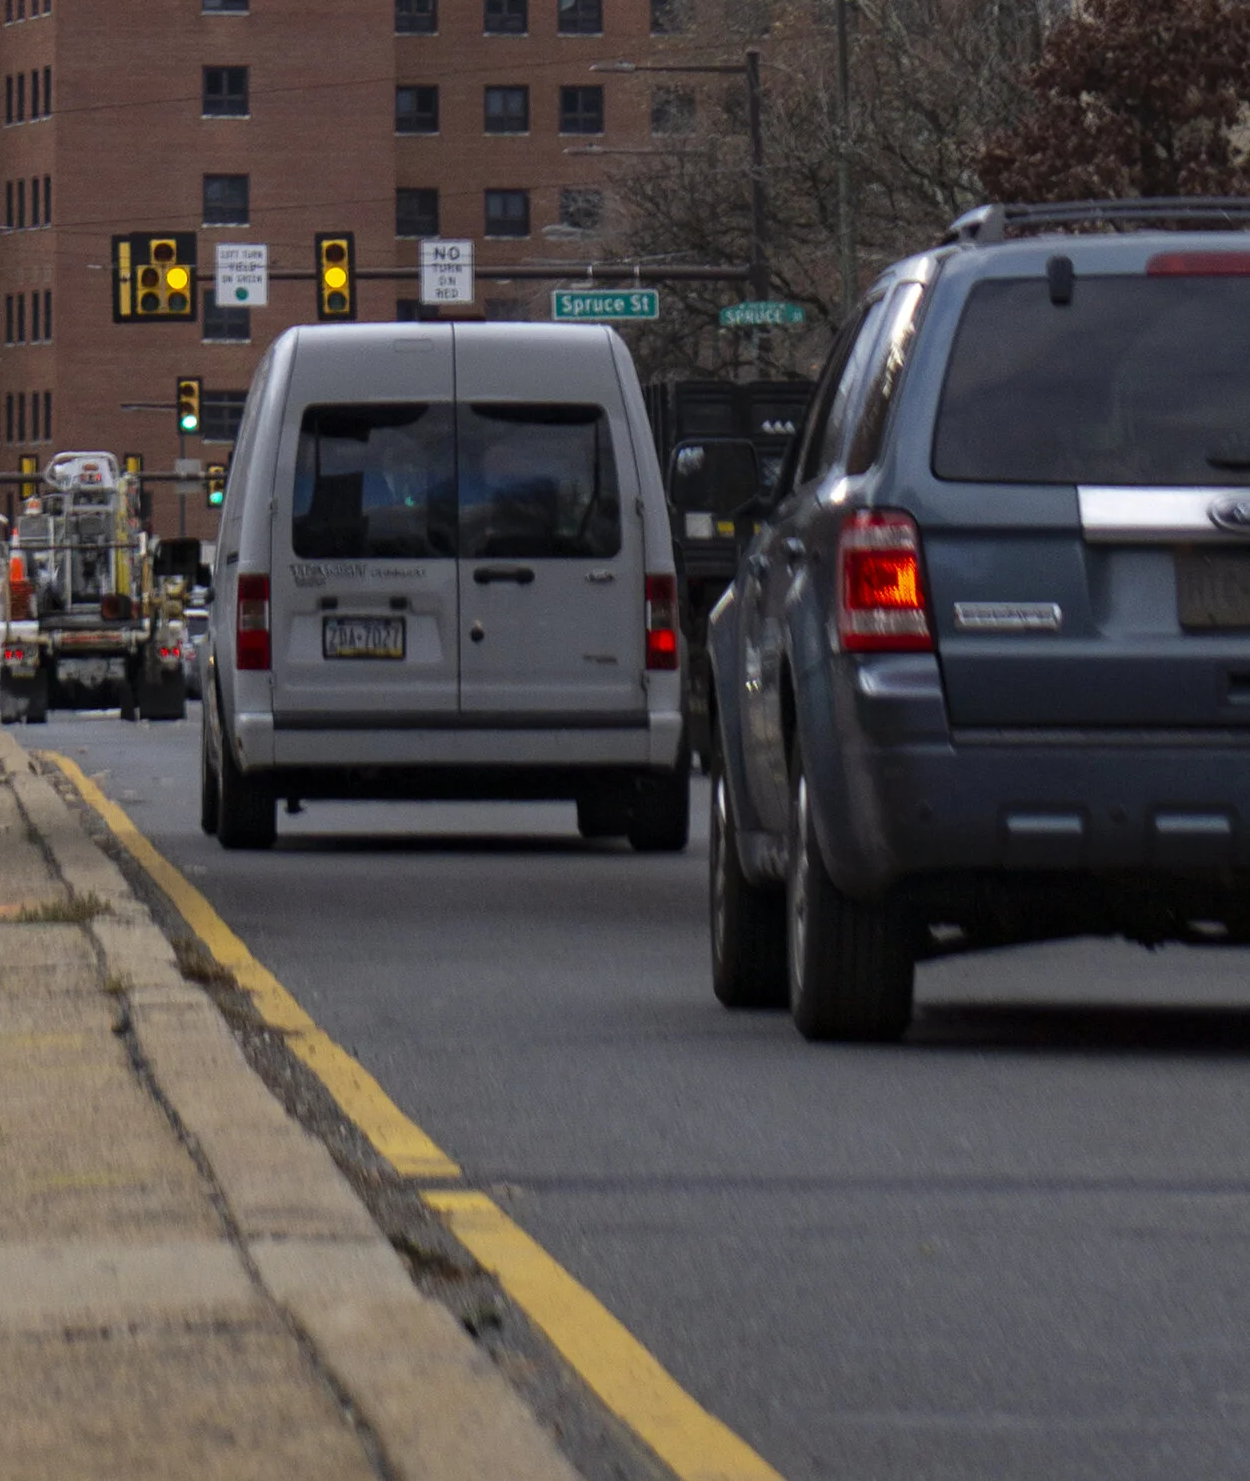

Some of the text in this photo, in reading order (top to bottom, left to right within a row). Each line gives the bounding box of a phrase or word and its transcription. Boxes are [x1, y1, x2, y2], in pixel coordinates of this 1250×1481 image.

[433, 247, 461, 260] NO
[431, 263, 463, 273] TURN
[438, 276, 456, 285] ON
[435, 288, 459, 298] RED
[561, 294, 649, 315] Spruce St
